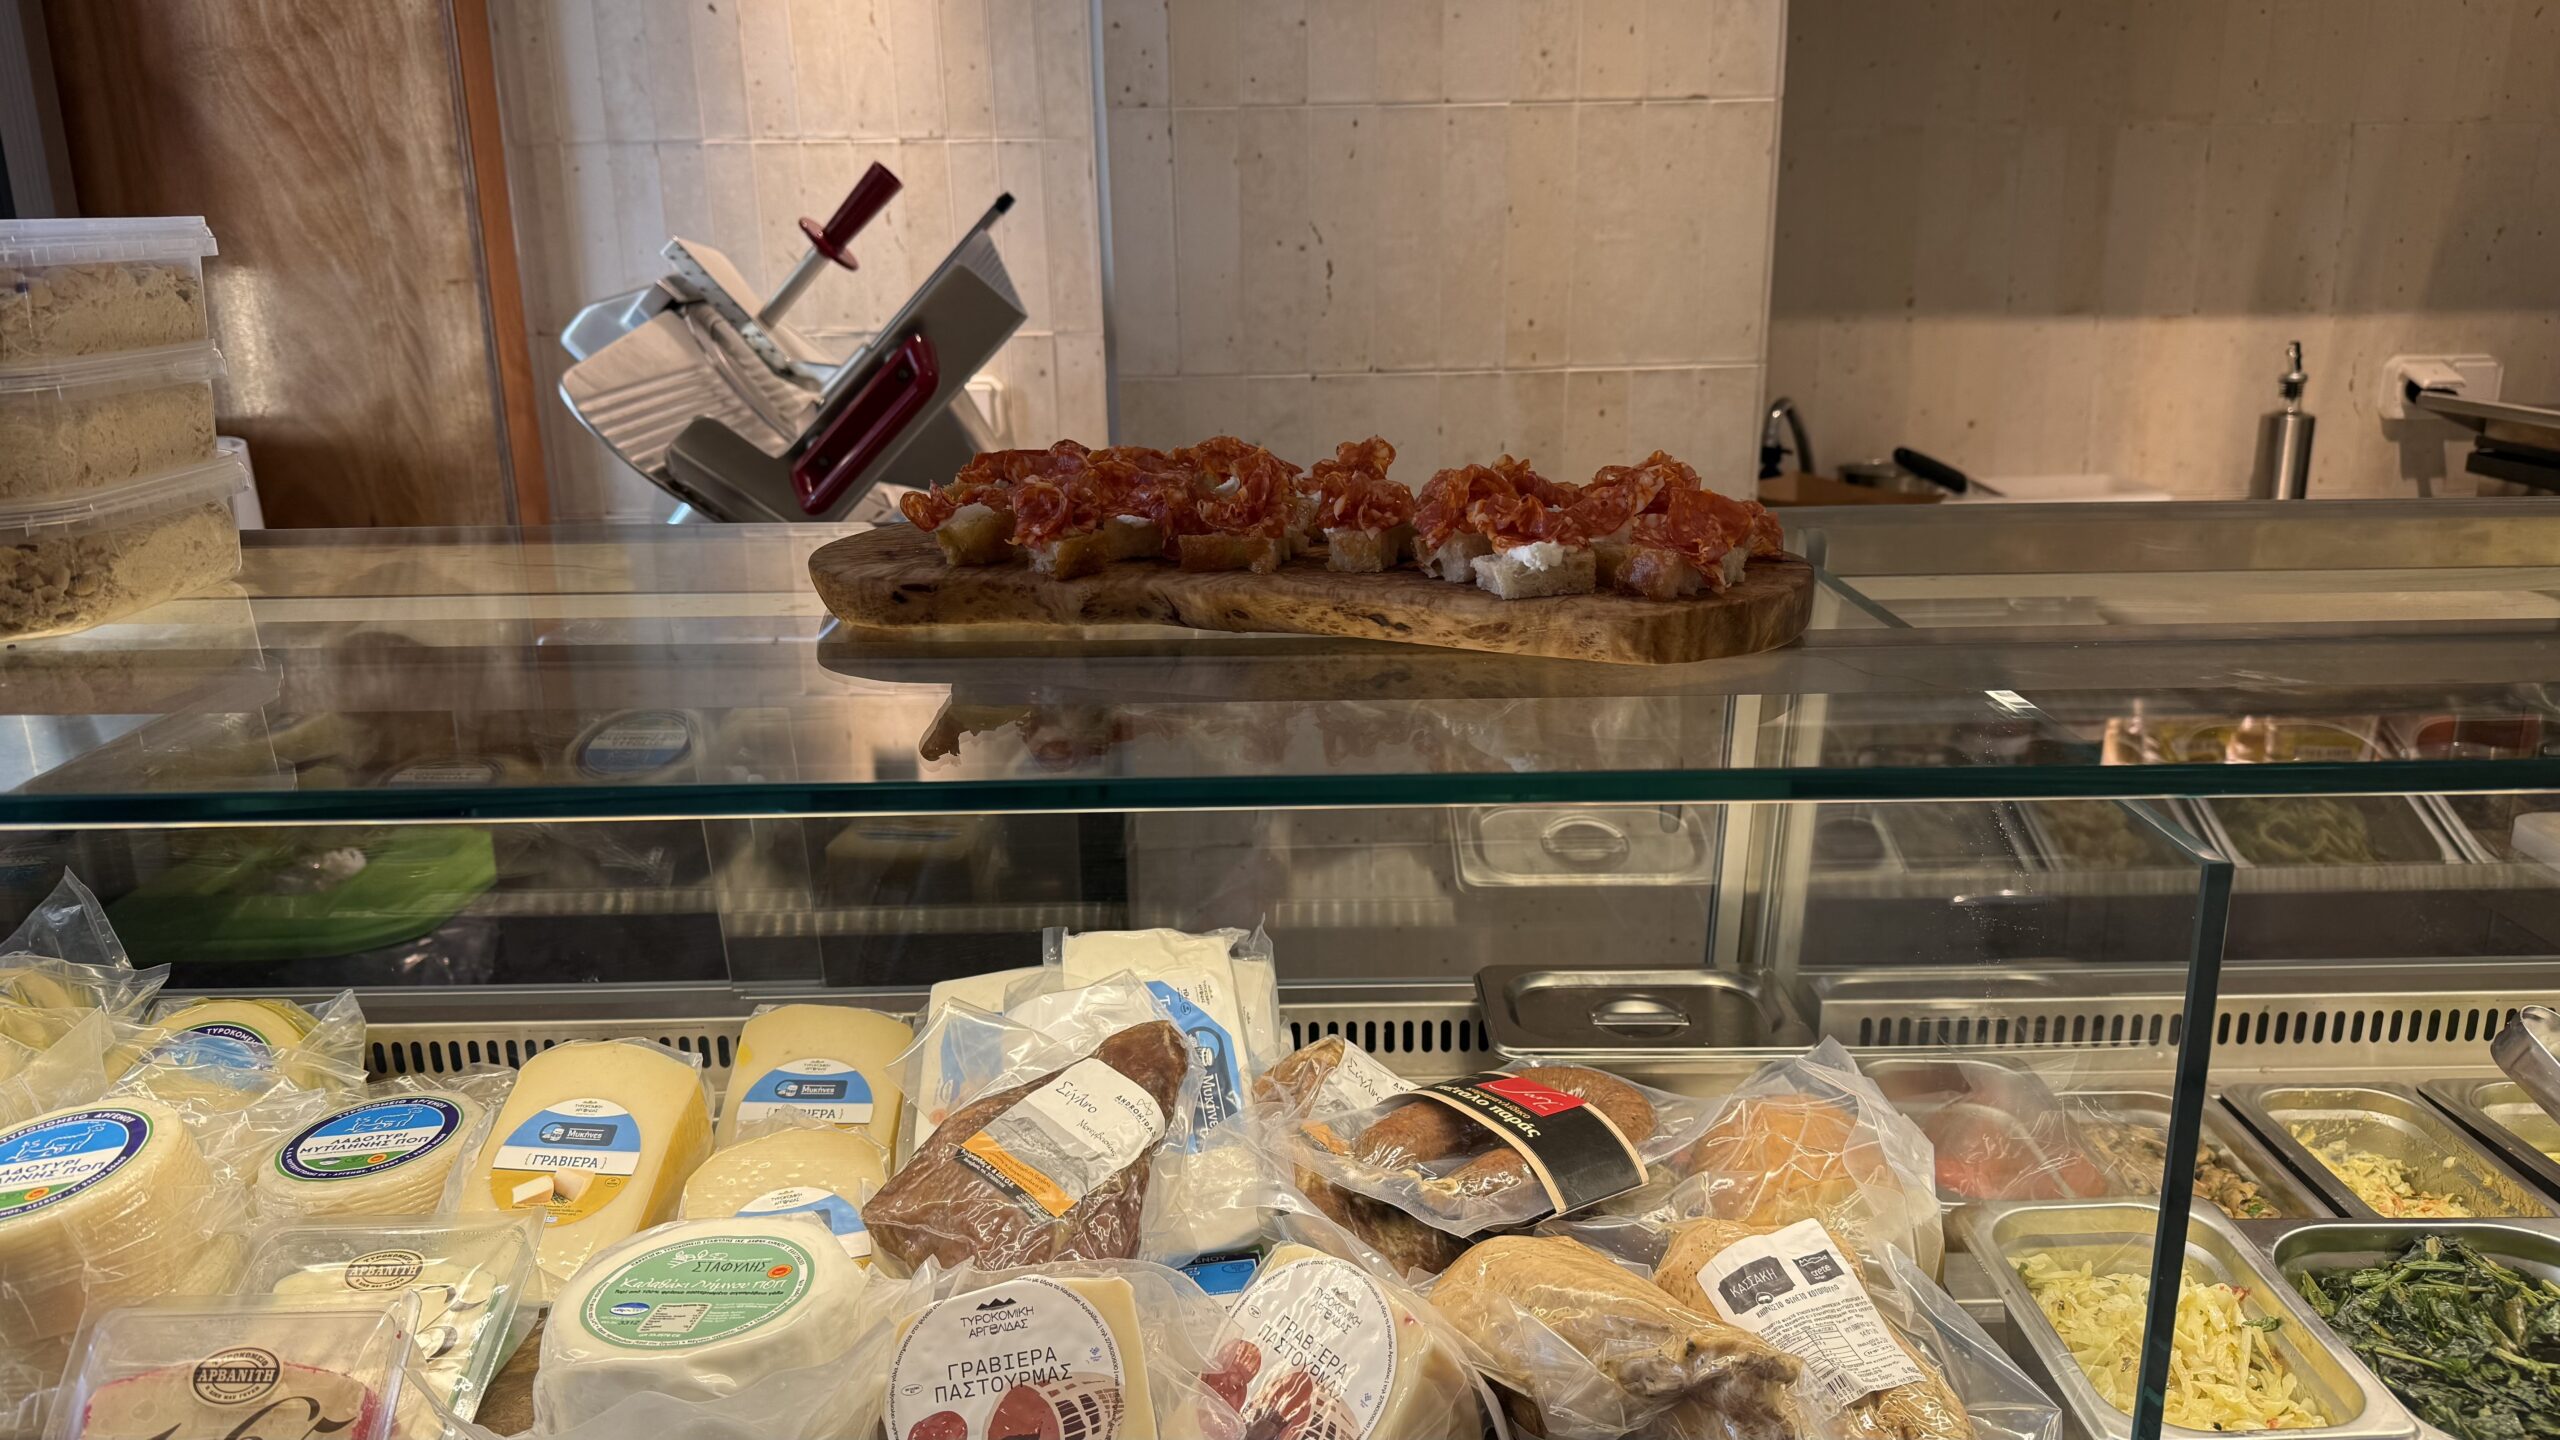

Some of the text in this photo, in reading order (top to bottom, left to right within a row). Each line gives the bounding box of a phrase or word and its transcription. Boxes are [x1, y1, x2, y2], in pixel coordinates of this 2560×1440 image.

[0, 1112, 136, 1144] ΤΥΡΟΚΟΜΕΙΟ ΑΡΓΕΝΟΥ
[1488, 1105, 1541, 1138] παράς
[300, 1140, 391, 1154] ΜΥΤΙΛΗΝΗΣ
[395, 1136, 430, 1146] ΠΟΠ
[330, 1132, 408, 1145] ΛΑΔΟΤΥΡΙ
[0, 1158, 81, 1177] ΑΔΟΤΥΡΙ
[63, 1161, 105, 1176] ΠΟΠ
[349, 1265, 417, 1276] ΑΡΒΑΝΙΤΗ
[692, 1261, 772, 1273] ΣΤΑΦΥΛΗΣ
[1810, 1264, 1832, 1278] crete
[620, 1278, 788, 1292] Καλαθάκι Λήμνου ΠΟΠ
[1729, 1268, 1778, 1297] ΚΑΣΣΑΚΗ
[1784, 1292, 1808, 1306] ΦΙΛΕΤΟ
[960, 1305, 1034, 1327] ΤΥΡΟΚΟΜΙΚΗ
[948, 1347, 1057, 1380] ΓΡΑΒΙΕΡΑ
[1258, 1325, 1347, 1404] ΠΑΣΤΟΥΡΜΑΣ
[197, 1369, 275, 1382] ΑΡΒΑΝΙΤΗ
[935, 1363, 1073, 1403] ΠΑΣΤΟΥΡΜΑΣ
